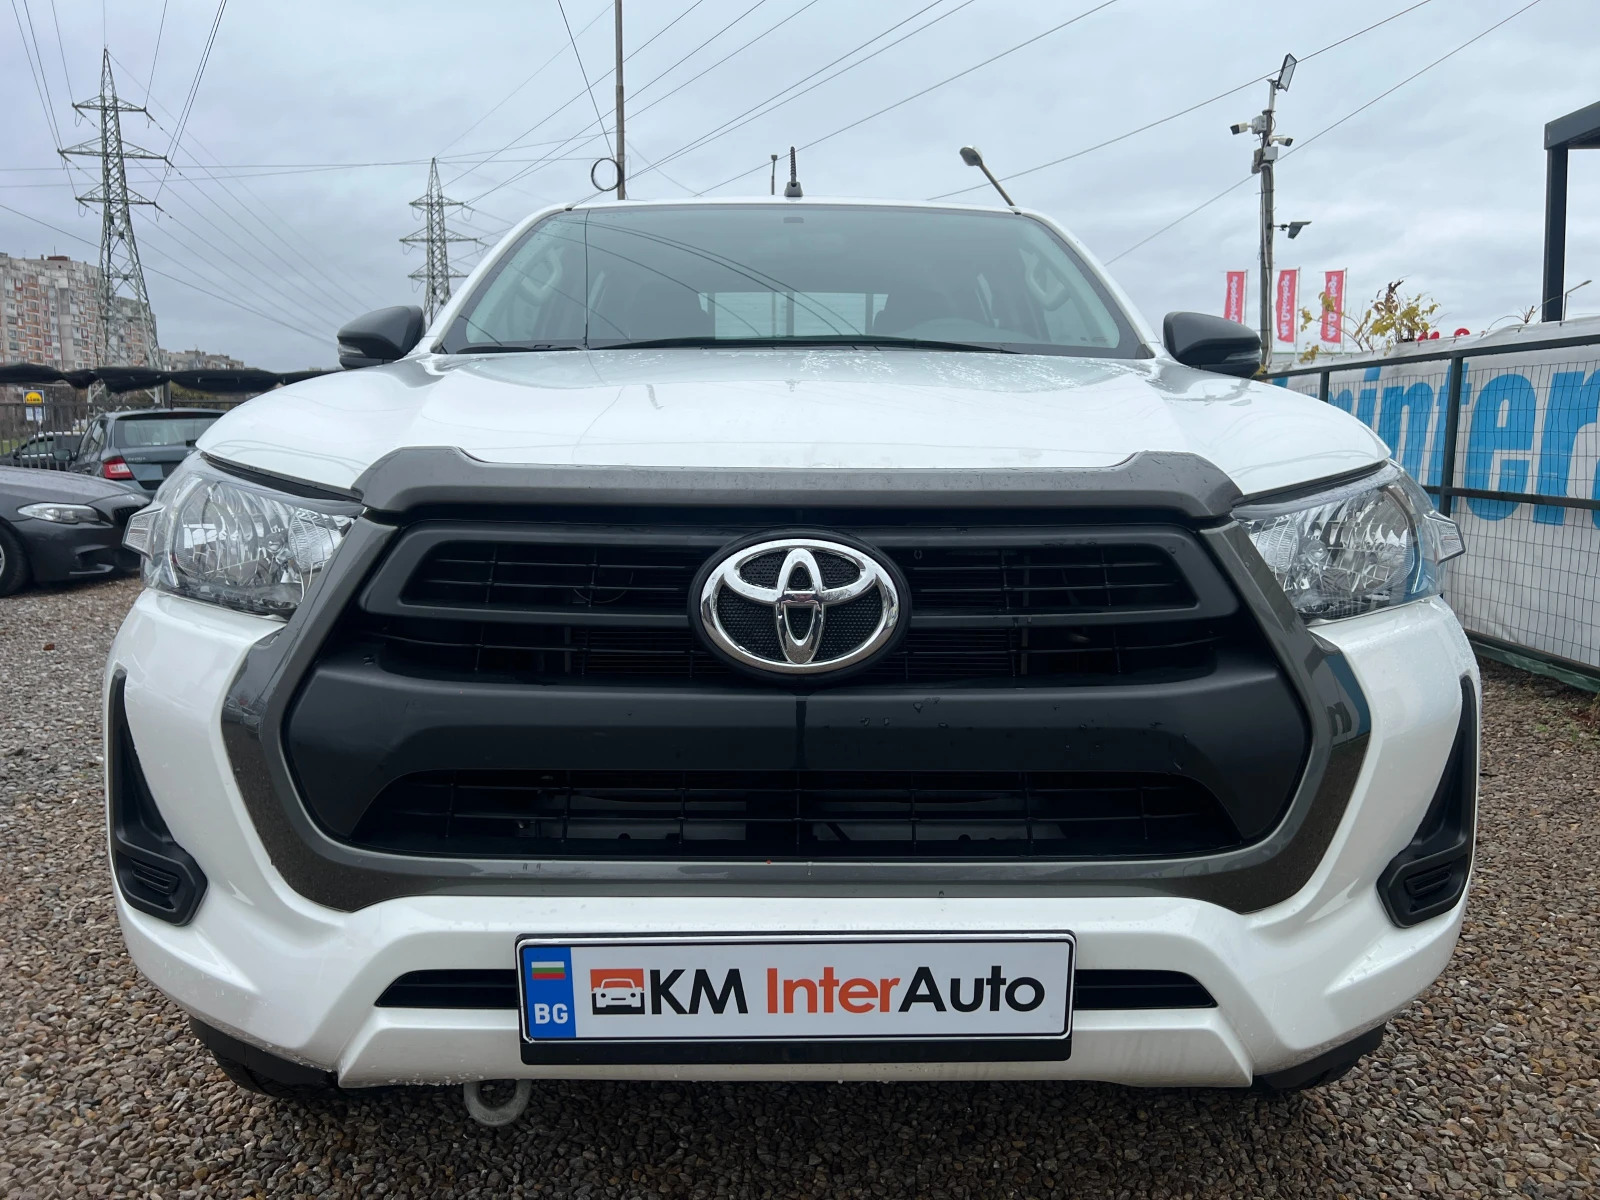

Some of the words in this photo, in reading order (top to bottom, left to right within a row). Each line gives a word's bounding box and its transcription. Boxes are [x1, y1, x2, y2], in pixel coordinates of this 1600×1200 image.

[649, 968, 749, 1015] KM
[767, 966, 1045, 1014] InterAuto
[534, 1003, 568, 1025] BG
